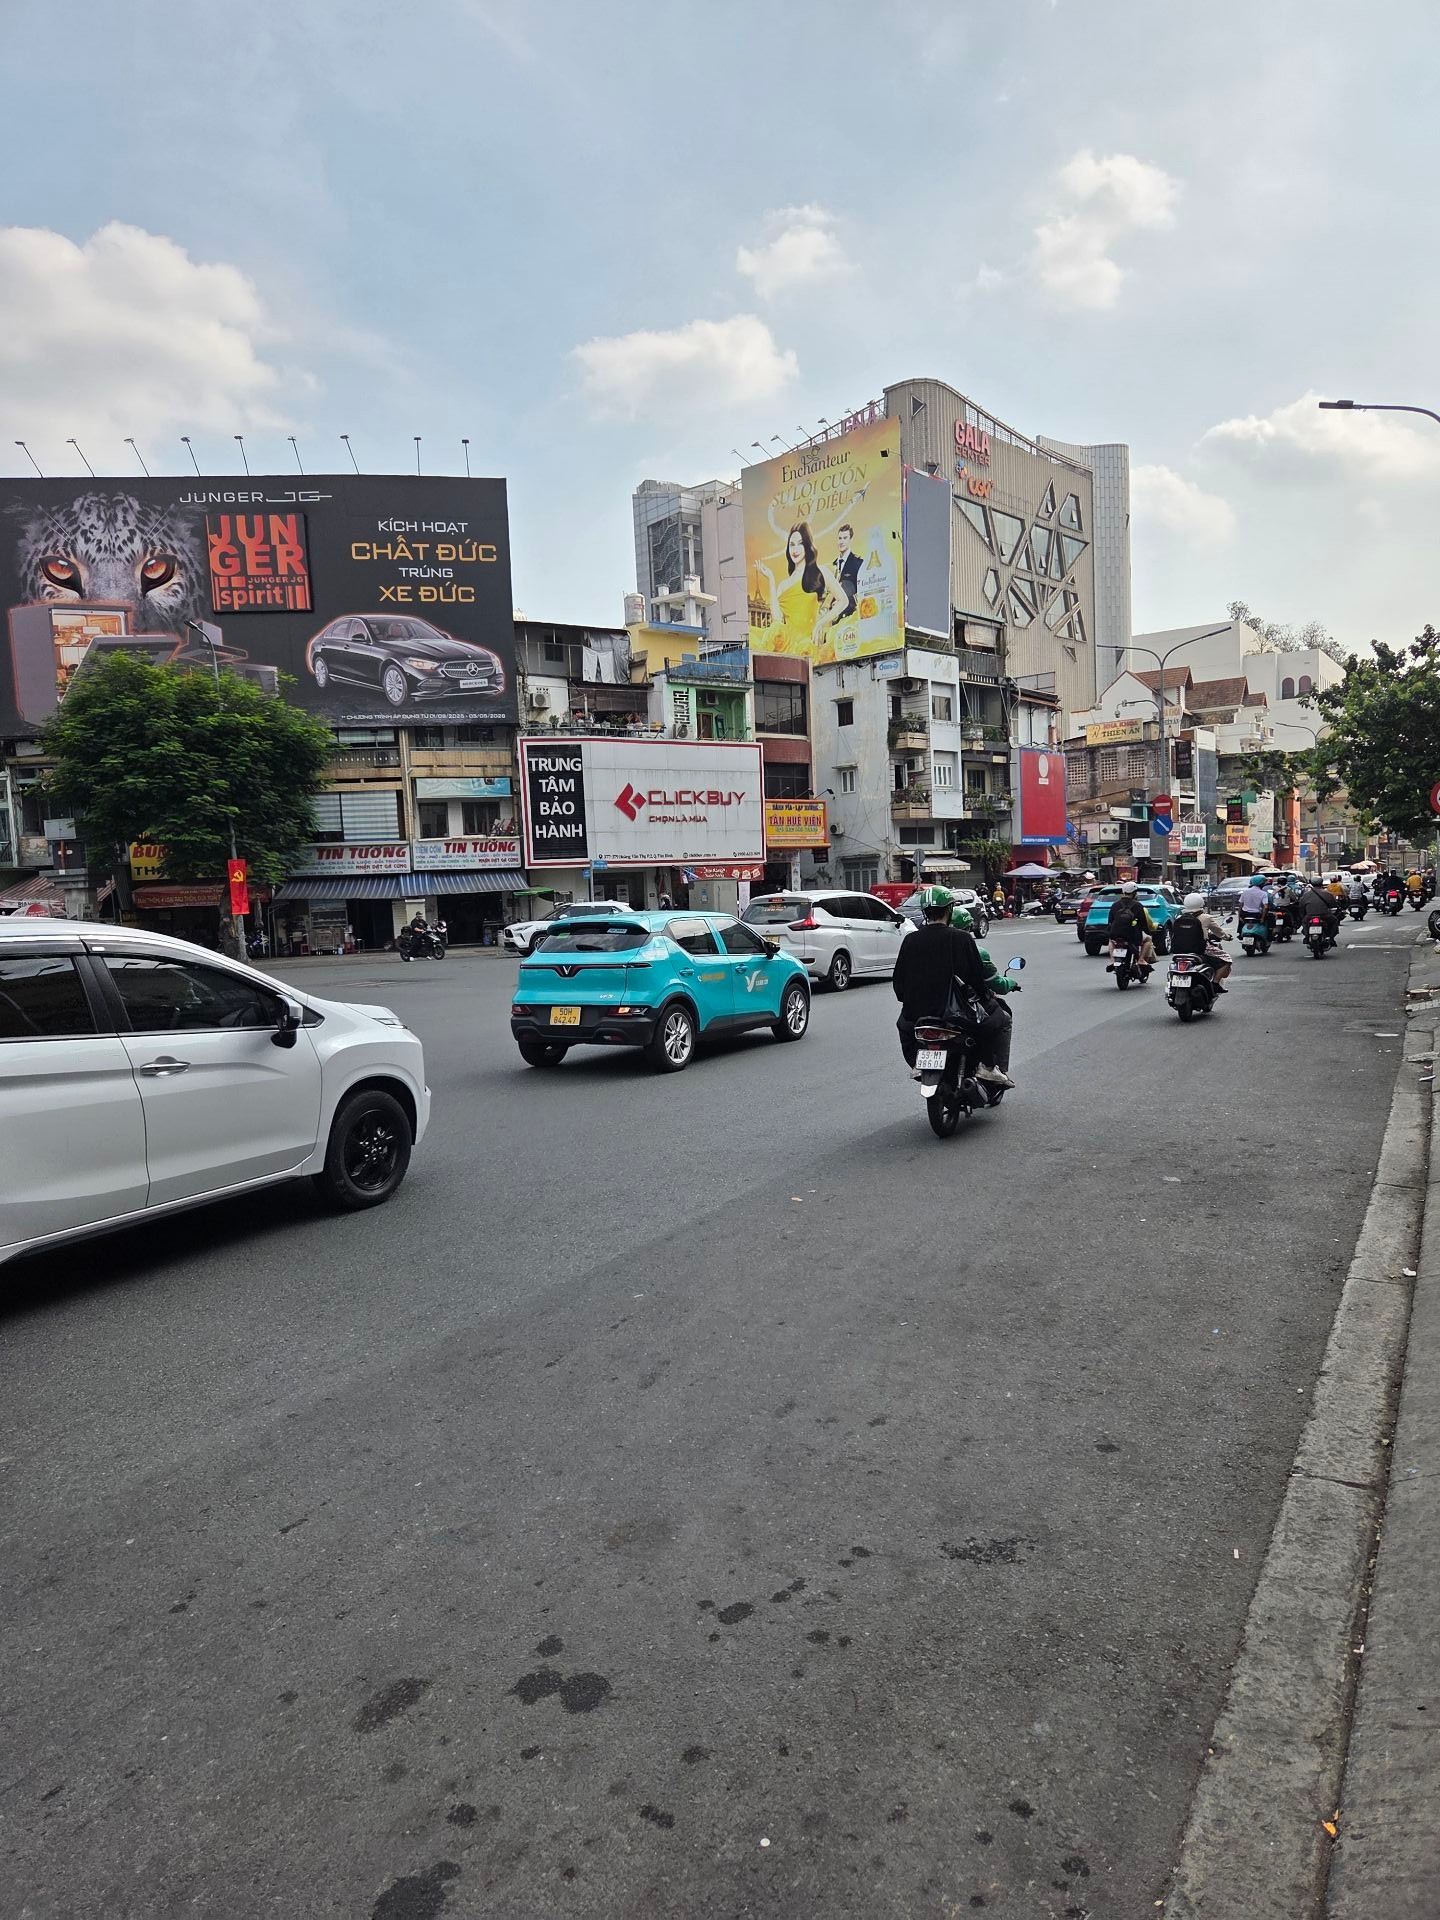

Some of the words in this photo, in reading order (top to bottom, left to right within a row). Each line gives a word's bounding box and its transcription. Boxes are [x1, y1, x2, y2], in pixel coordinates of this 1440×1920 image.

[955, 420, 990, 456] GALA
[782, 451, 850, 483] Enchanteur
[967, 476, 993, 497] CGV
[209, 514, 298, 546] JUN
[378, 517, 418, 532] KÍCH
[422, 521, 469, 536] HOẠT
[351, 534, 430, 560] CHẤT
[436, 538, 497, 561] ĐỨC
[210, 544, 307, 576] GER
[398, 564, 454, 578] TRÚNG
[221, 584, 283, 611] spirit
[379, 585, 413, 602] XE
[418, 581, 475, 602] ĐỨC
[528, 757, 582, 772] TRUNG
[539, 775, 575, 793] TÂM
[540, 795, 575, 815] BẢO
[647, 790, 746, 806] CLICKBUY
[649, 815, 677, 825] CHỌN
[769, 814, 784, 825] TÂN
[535, 820, 583, 839] HÀNH
[317, 848, 344, 860] TIN
[444, 842, 467, 853] TIN
